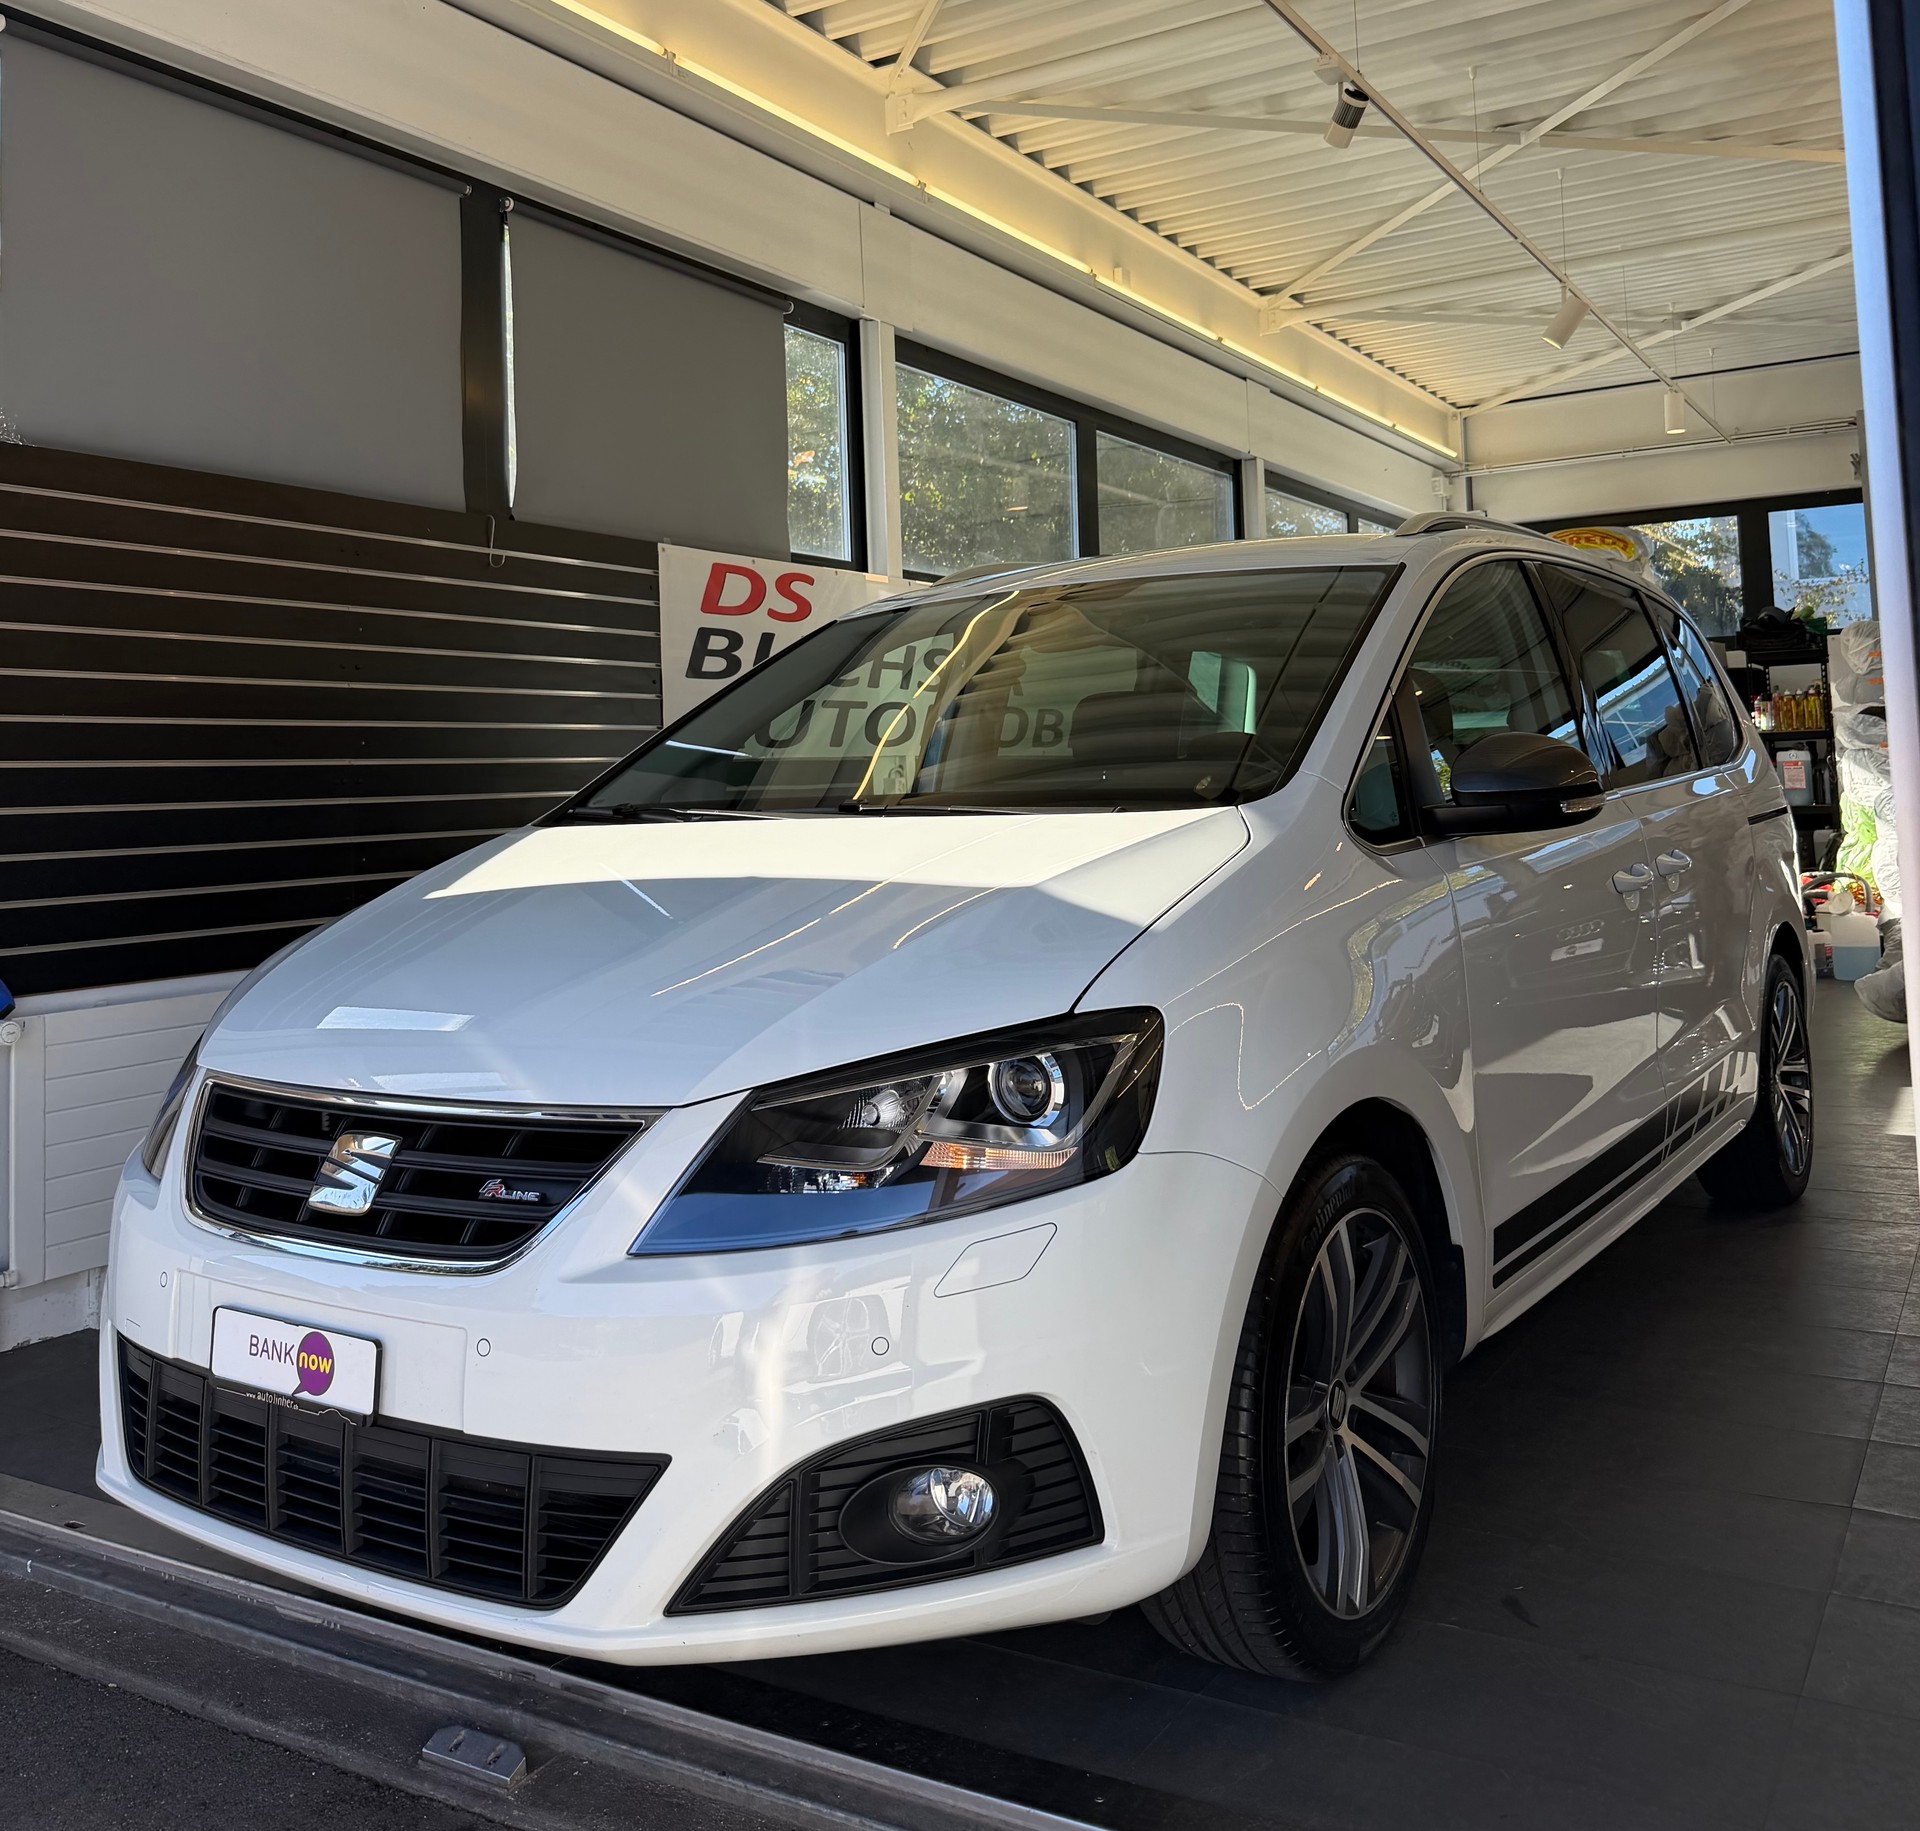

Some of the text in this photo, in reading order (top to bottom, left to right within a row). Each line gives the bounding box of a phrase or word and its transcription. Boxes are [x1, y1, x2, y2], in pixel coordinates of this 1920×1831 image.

[700, 562, 815, 623] DS
[501, 1190, 540, 1202] LINE
[249, 1334, 332, 1374] BANK now
